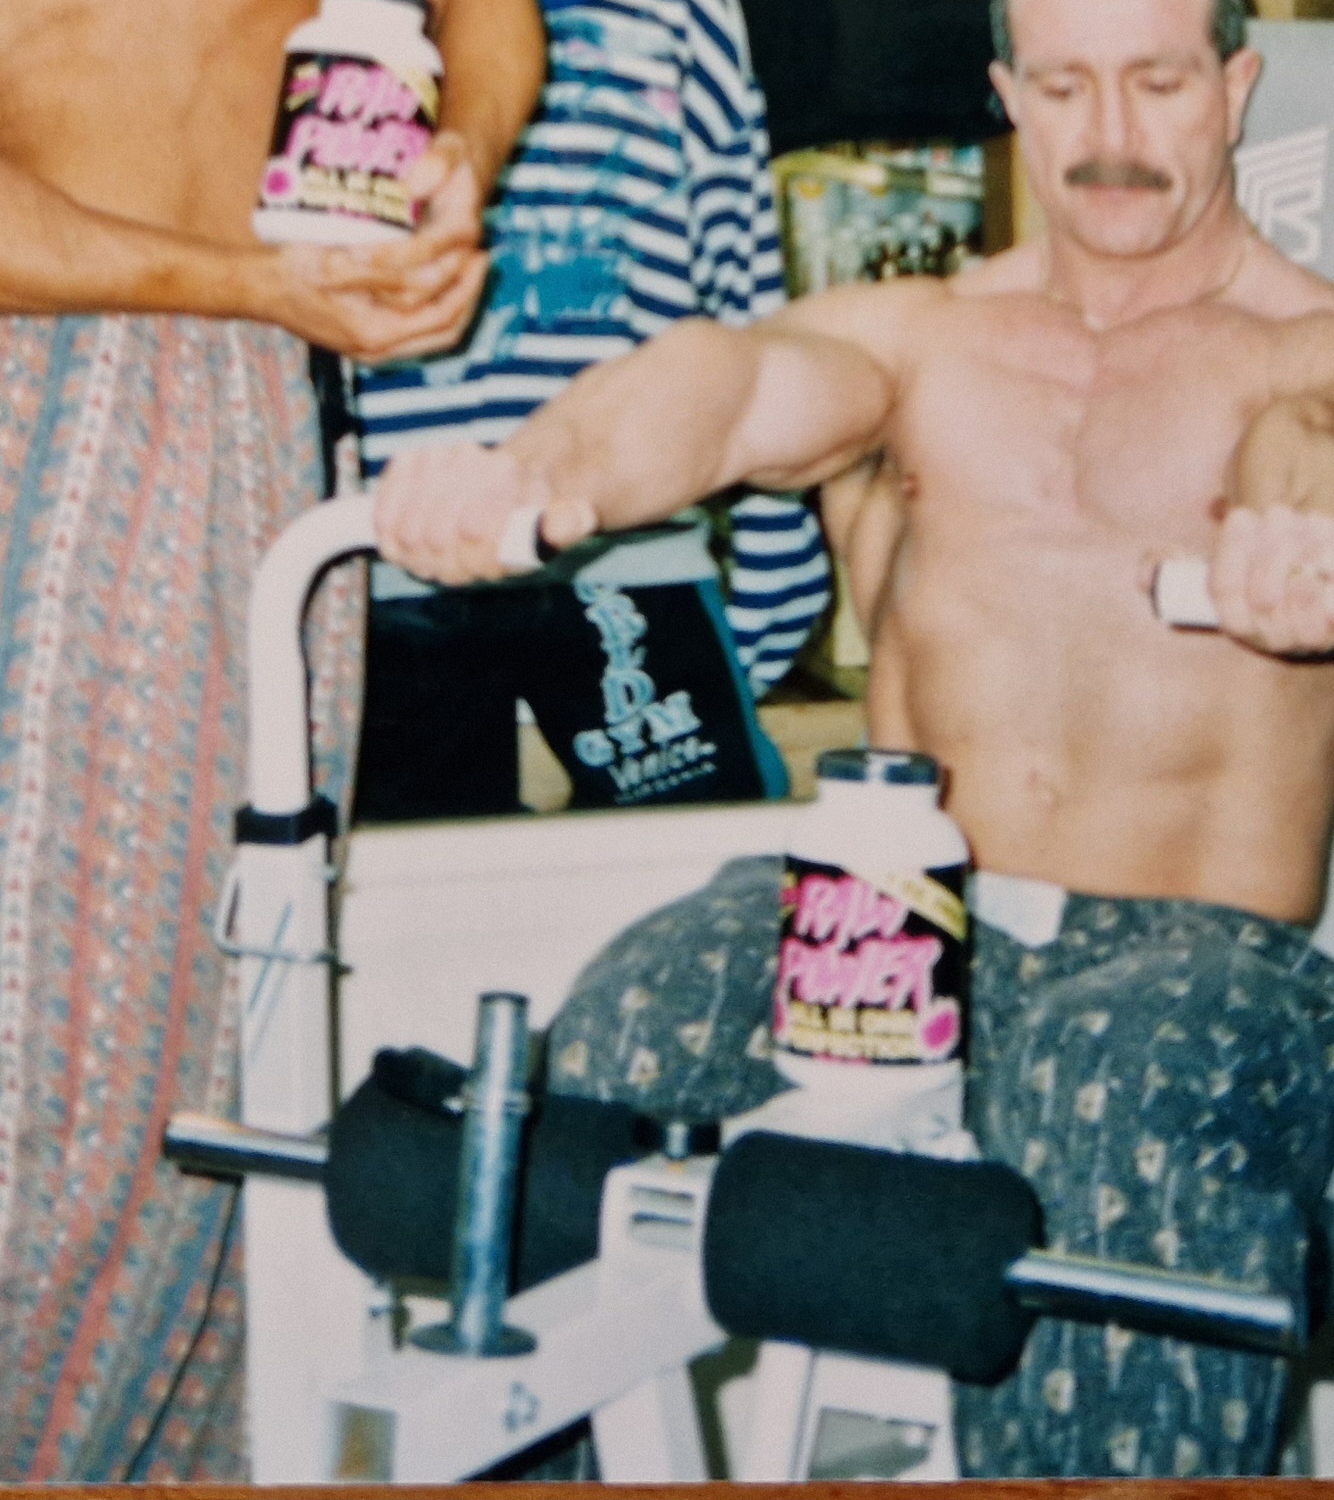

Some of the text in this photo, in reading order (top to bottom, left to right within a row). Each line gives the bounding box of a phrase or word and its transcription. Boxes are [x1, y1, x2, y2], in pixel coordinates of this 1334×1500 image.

[573, 691, 702, 768] GYM
[794, 873, 909, 948] RAW
[775, 932, 944, 1013] POWER
